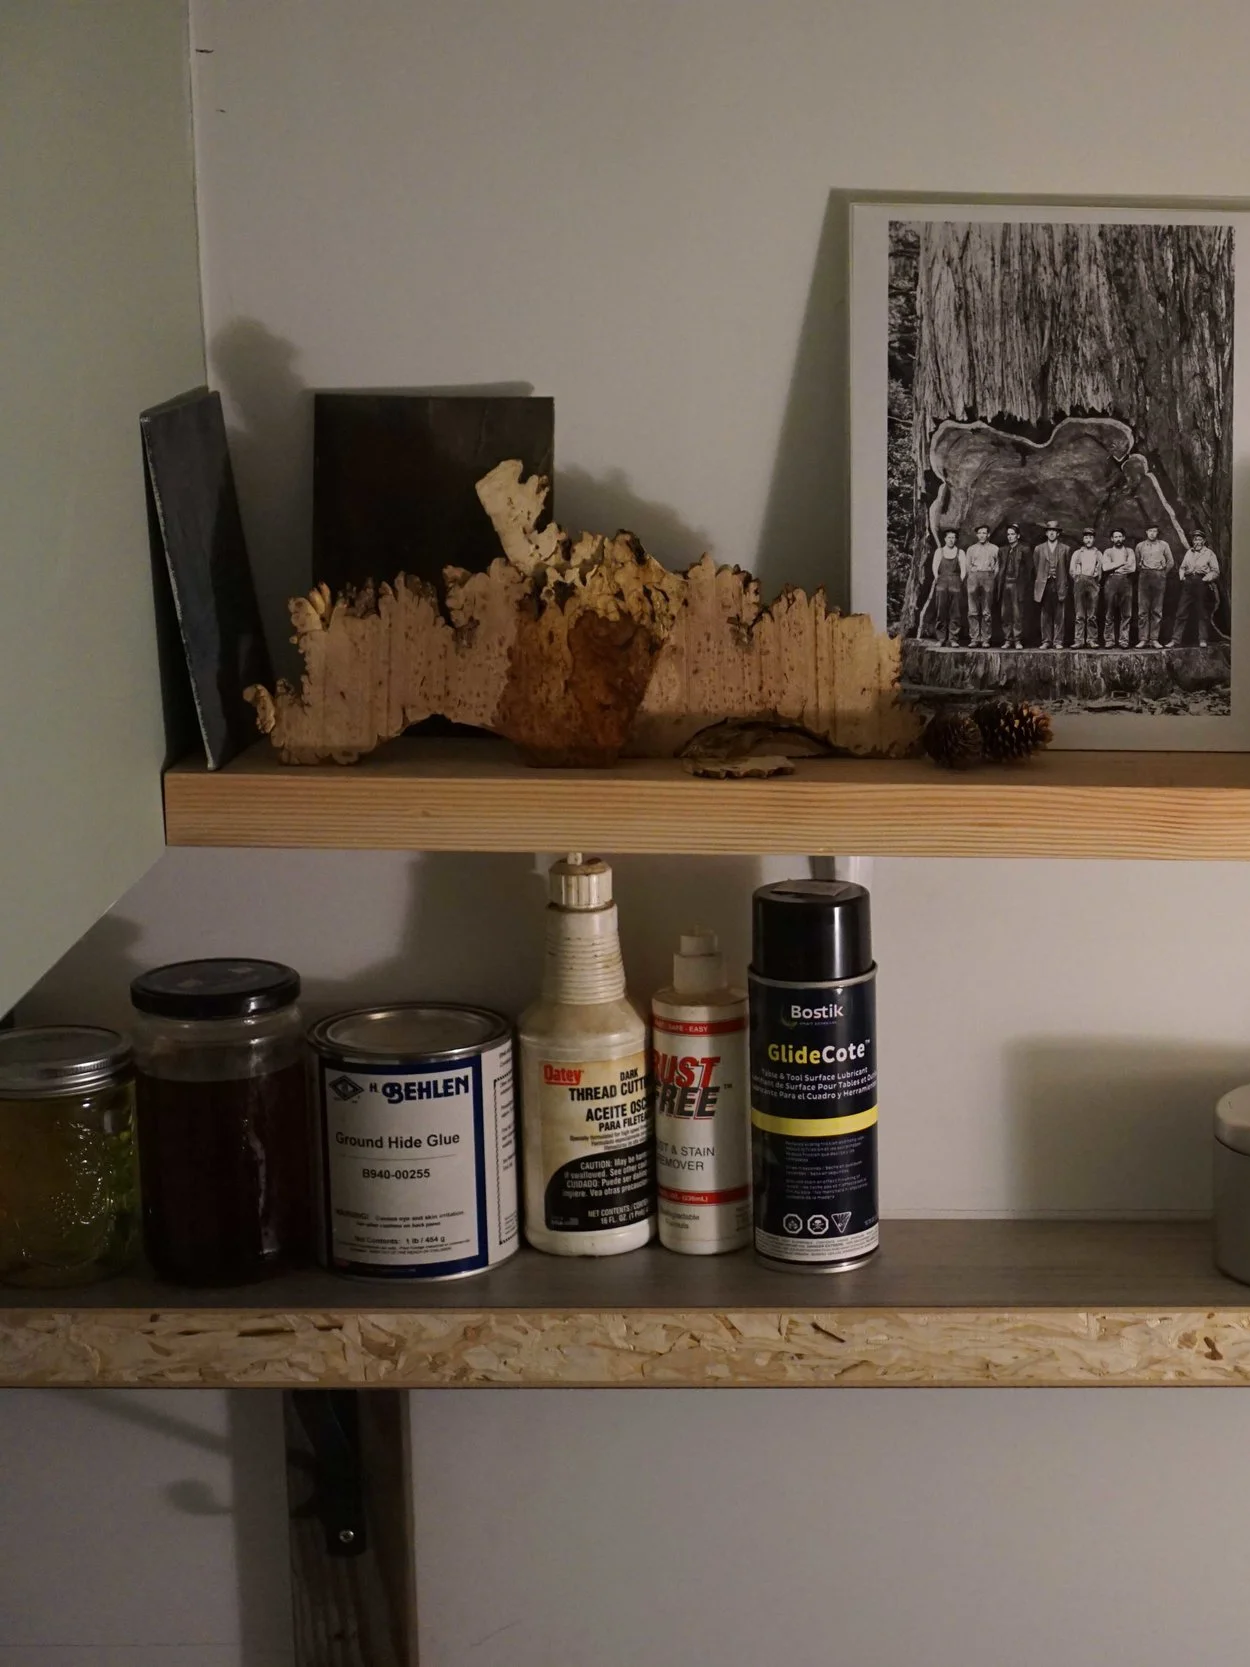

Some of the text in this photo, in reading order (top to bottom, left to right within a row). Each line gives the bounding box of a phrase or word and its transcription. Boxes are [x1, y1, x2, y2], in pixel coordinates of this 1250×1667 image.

[791, 1004, 844, 1019] Bostik
[688, 1024, 709, 1033] EASY
[544, 1064, 582, 1083] Oatey
[620, 1068, 639, 1082] DARK
[786, 1073, 803, 1082] Tool
[804, 1072, 836, 1082] Surface
[837, 1066, 869, 1080] Lubricant
[382, 1075, 469, 1105] BEHLEN
[785, 1081, 816, 1091] Surface
[817, 1082, 837, 1091] Pour
[838, 1079, 860, 1090] Tables
[860, 1076, 867, 1084] et
[569, 1085, 618, 1102] THREAD
[779, 1091, 796, 1100] Para
[797, 1092, 805, 1100] el
[806, 1091, 836, 1101] Cuadro
[837, 1091, 842, 1100] y
[655, 1084, 721, 1119] REE
[586, 1104, 628, 1122] ACEITE
[599, 1120, 621, 1132] PARA
[336, 1132, 461, 1150] Ground Hide Glue
[671, 1145, 678, 1156] &
[681, 1145, 716, 1158] STAIN
[580, 1160, 613, 1170] CAUTION:
[614, 1158, 628, 1168] May
[628, 1155, 635, 1164] be
[363, 1169, 431, 1180] B940-00255
[570, 1169, 607, 1180] swallowed.
[609, 1168, 622, 1177] See
[622, 1165, 637, 1175] other
[601, 1177, 621, 1187] Puede
[622, 1175, 632, 1183] ser
[589, 1188, 603, 1197] Vea
[604, 1186, 620, 1196] otras
[588, 1209, 600, 1218] NET
[366, 1236, 401, 1244] Contents:
[411, 1236, 419, 1244] lb
[425, 1235, 438, 1244] 454
